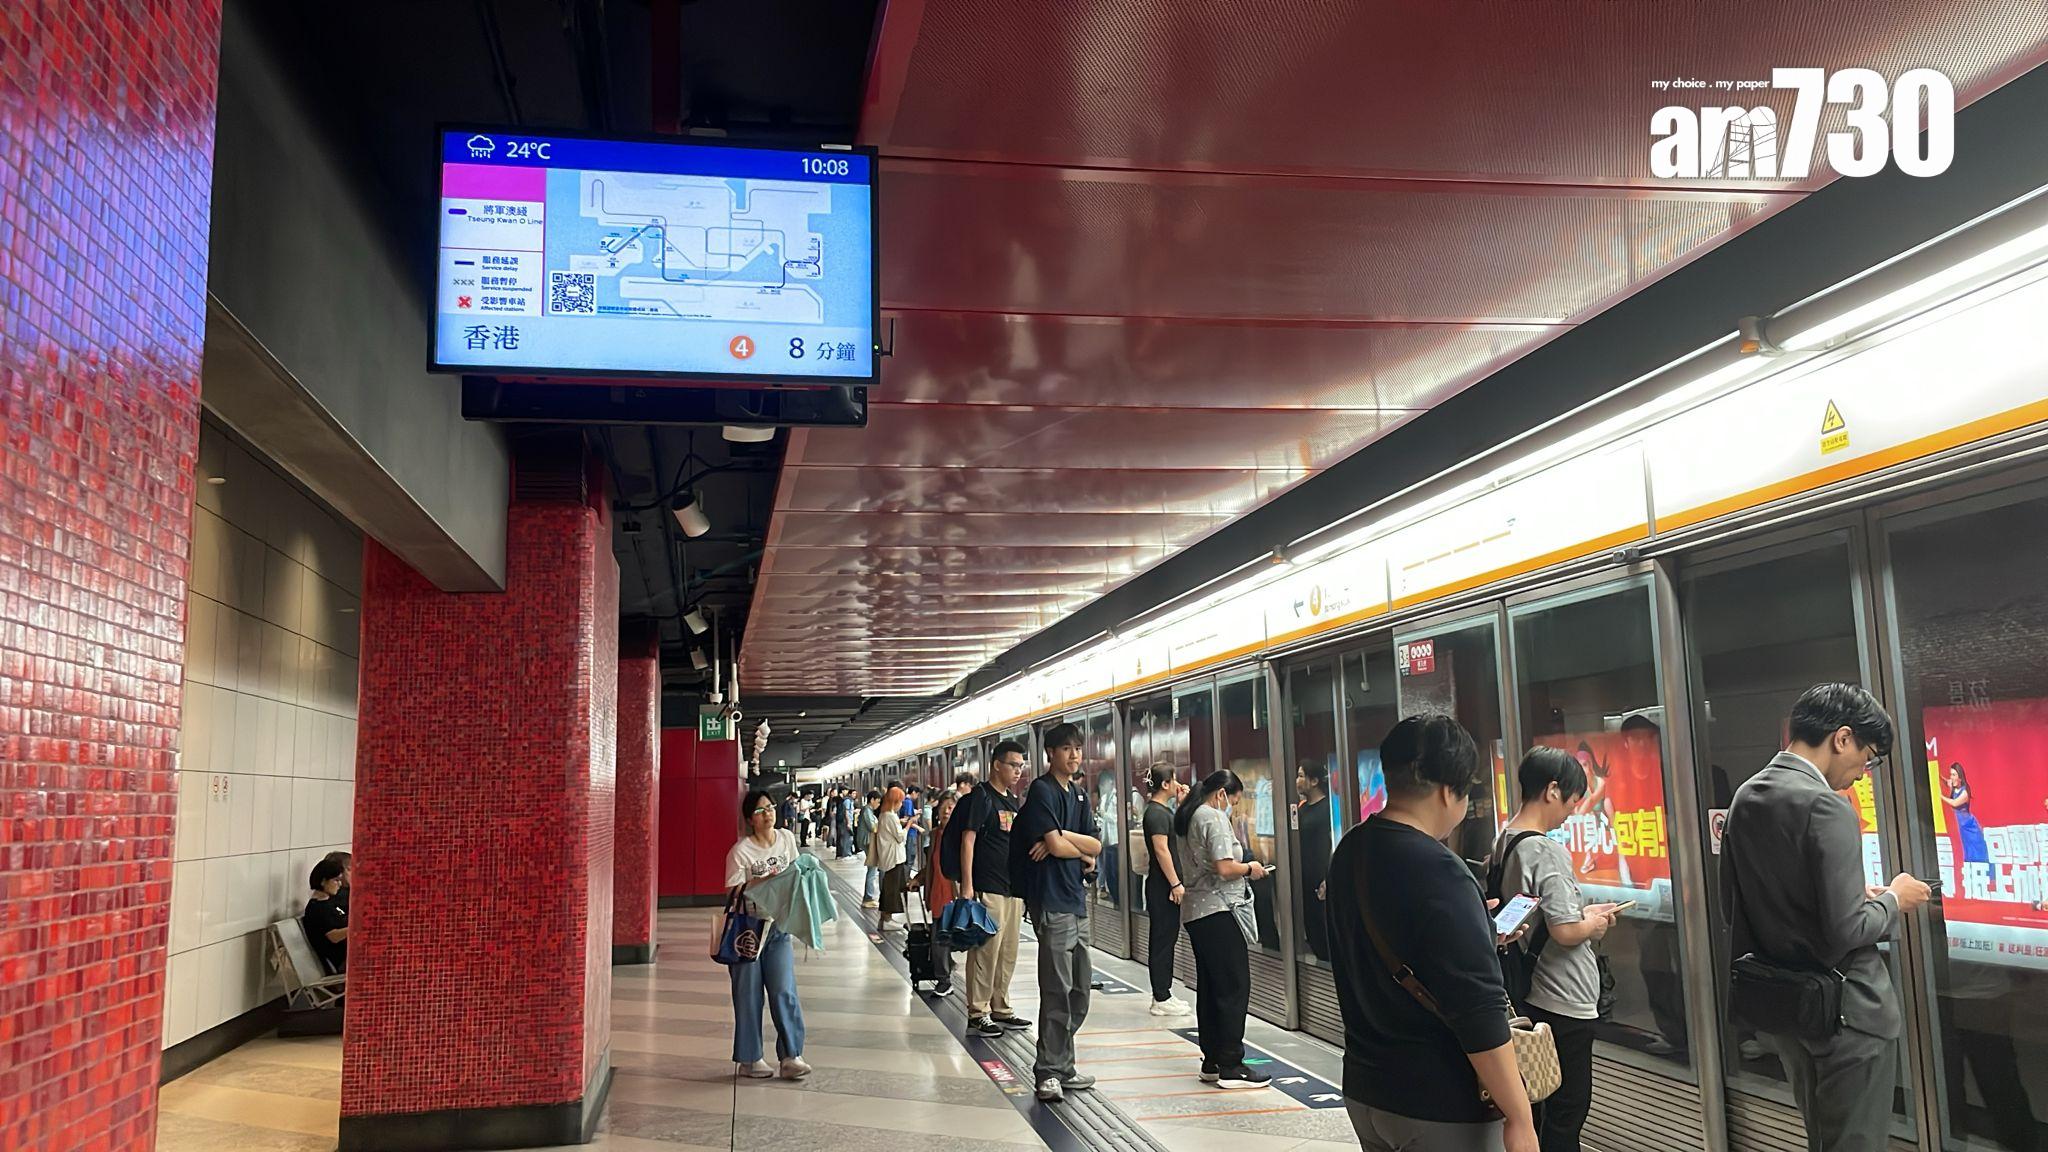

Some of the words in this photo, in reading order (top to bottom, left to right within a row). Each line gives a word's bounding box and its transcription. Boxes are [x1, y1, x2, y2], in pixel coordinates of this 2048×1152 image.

[801, 157, 849, 177] 10:08
[467, 216, 495, 224] Tseung
[463, 324, 520, 350] 香港
[734, 338, 749, 357] 4
[789, 337, 805, 359] 8
[816, 341, 856, 361] 分鐘
